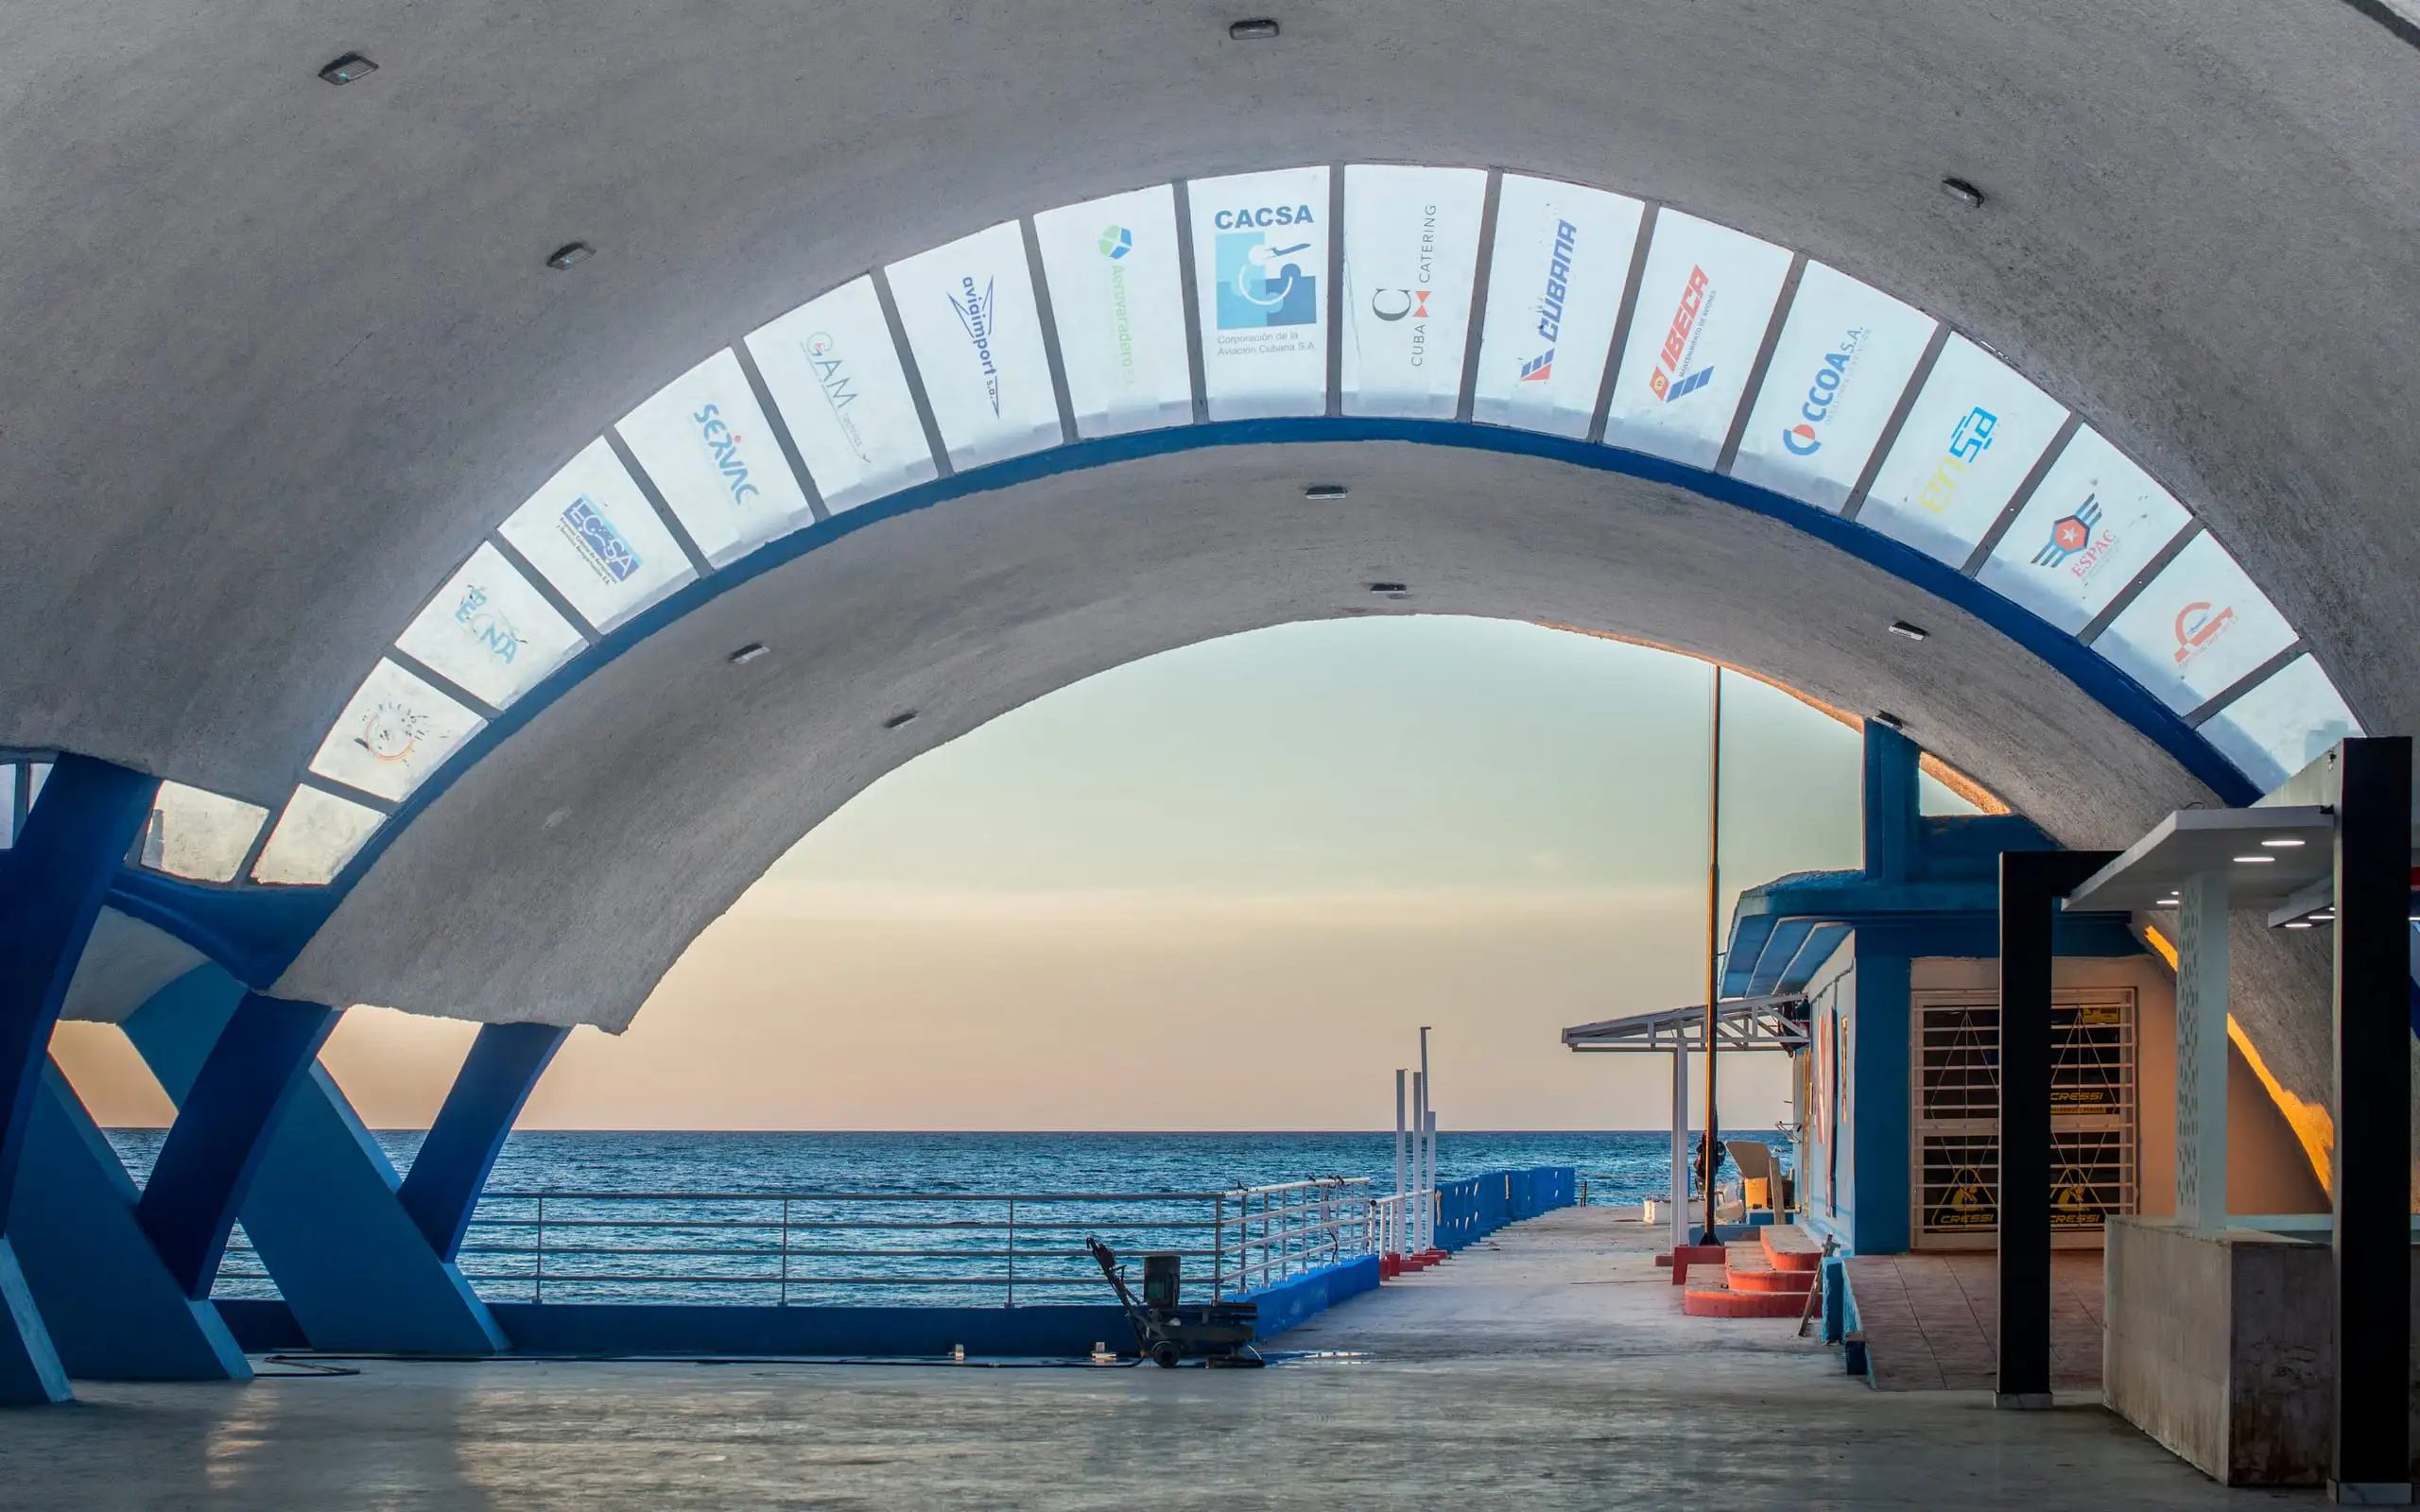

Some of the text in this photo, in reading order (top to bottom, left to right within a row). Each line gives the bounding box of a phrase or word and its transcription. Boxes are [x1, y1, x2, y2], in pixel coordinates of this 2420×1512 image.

[1215, 205, 1314, 230] CACSA
[1373, 288, 1411, 321] C
[1411, 205, 1436, 367] CUBA CATERING
[1539, 219, 1577, 343] CUBANA
[962, 276, 996, 375] aviaimport
[1276, 332, 1288, 340] de
[1289, 330, 1299, 340] la
[1661, 265, 1708, 371] IBECA
[806, 332, 857, 408] GAM
[1259, 343, 1295, 353] Cubana
[1803, 353, 1850, 421] CCOA
[1841, 327, 1863, 353] S.A.
[2071, 529, 2117, 577] ESPAC
[2049, 1092, 2103, 1101] CRESSI
[1940, 1213, 1994, 1224] CRESSI
